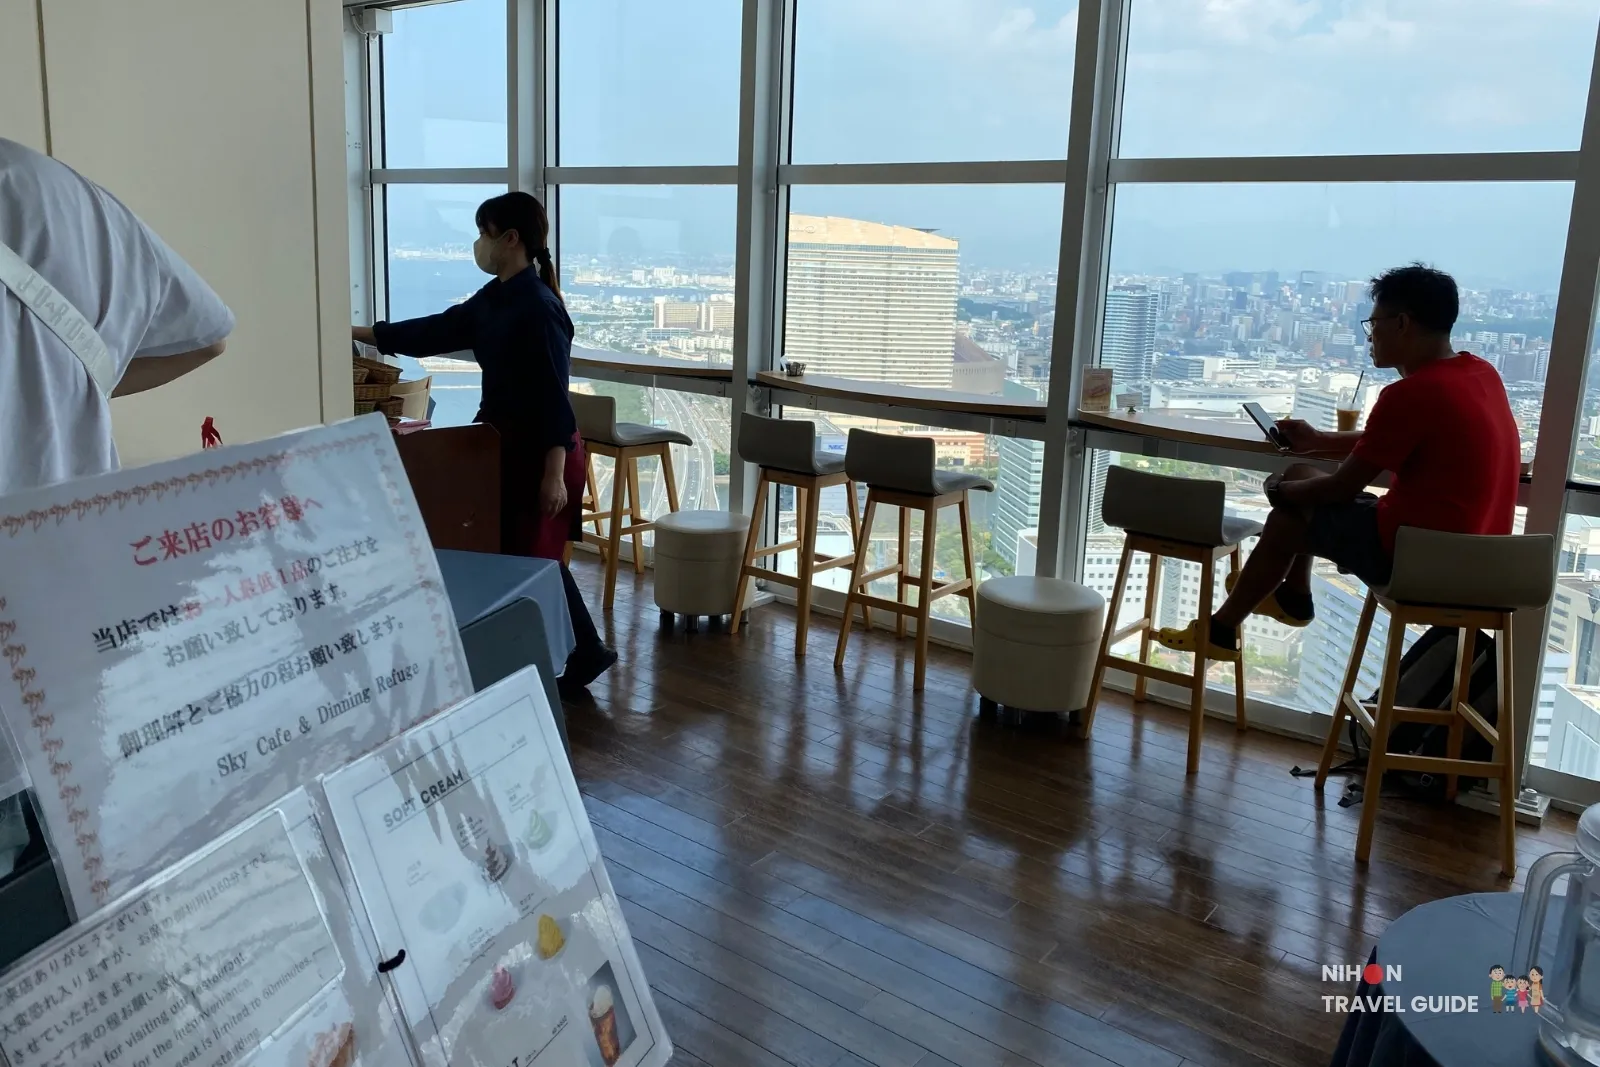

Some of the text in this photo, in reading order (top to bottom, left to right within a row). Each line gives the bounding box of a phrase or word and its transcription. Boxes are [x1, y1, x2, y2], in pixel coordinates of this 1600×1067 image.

[130, 495, 323, 566] ご来店のお客様へ
[163, 583, 347, 668] お願い致しております。
[217, 661, 420, 777] Sky Cafe & Dinning Refuge
[420, 770, 464, 804] CREAM
[104, 1044, 123, 1064] for
[125, 1010, 169, 1047] visiting
[152, 1039, 173, 1059] the
[201, 1037, 213, 1050] is
[212, 1003, 249, 1040] limited
[250, 997, 262, 1012] to
